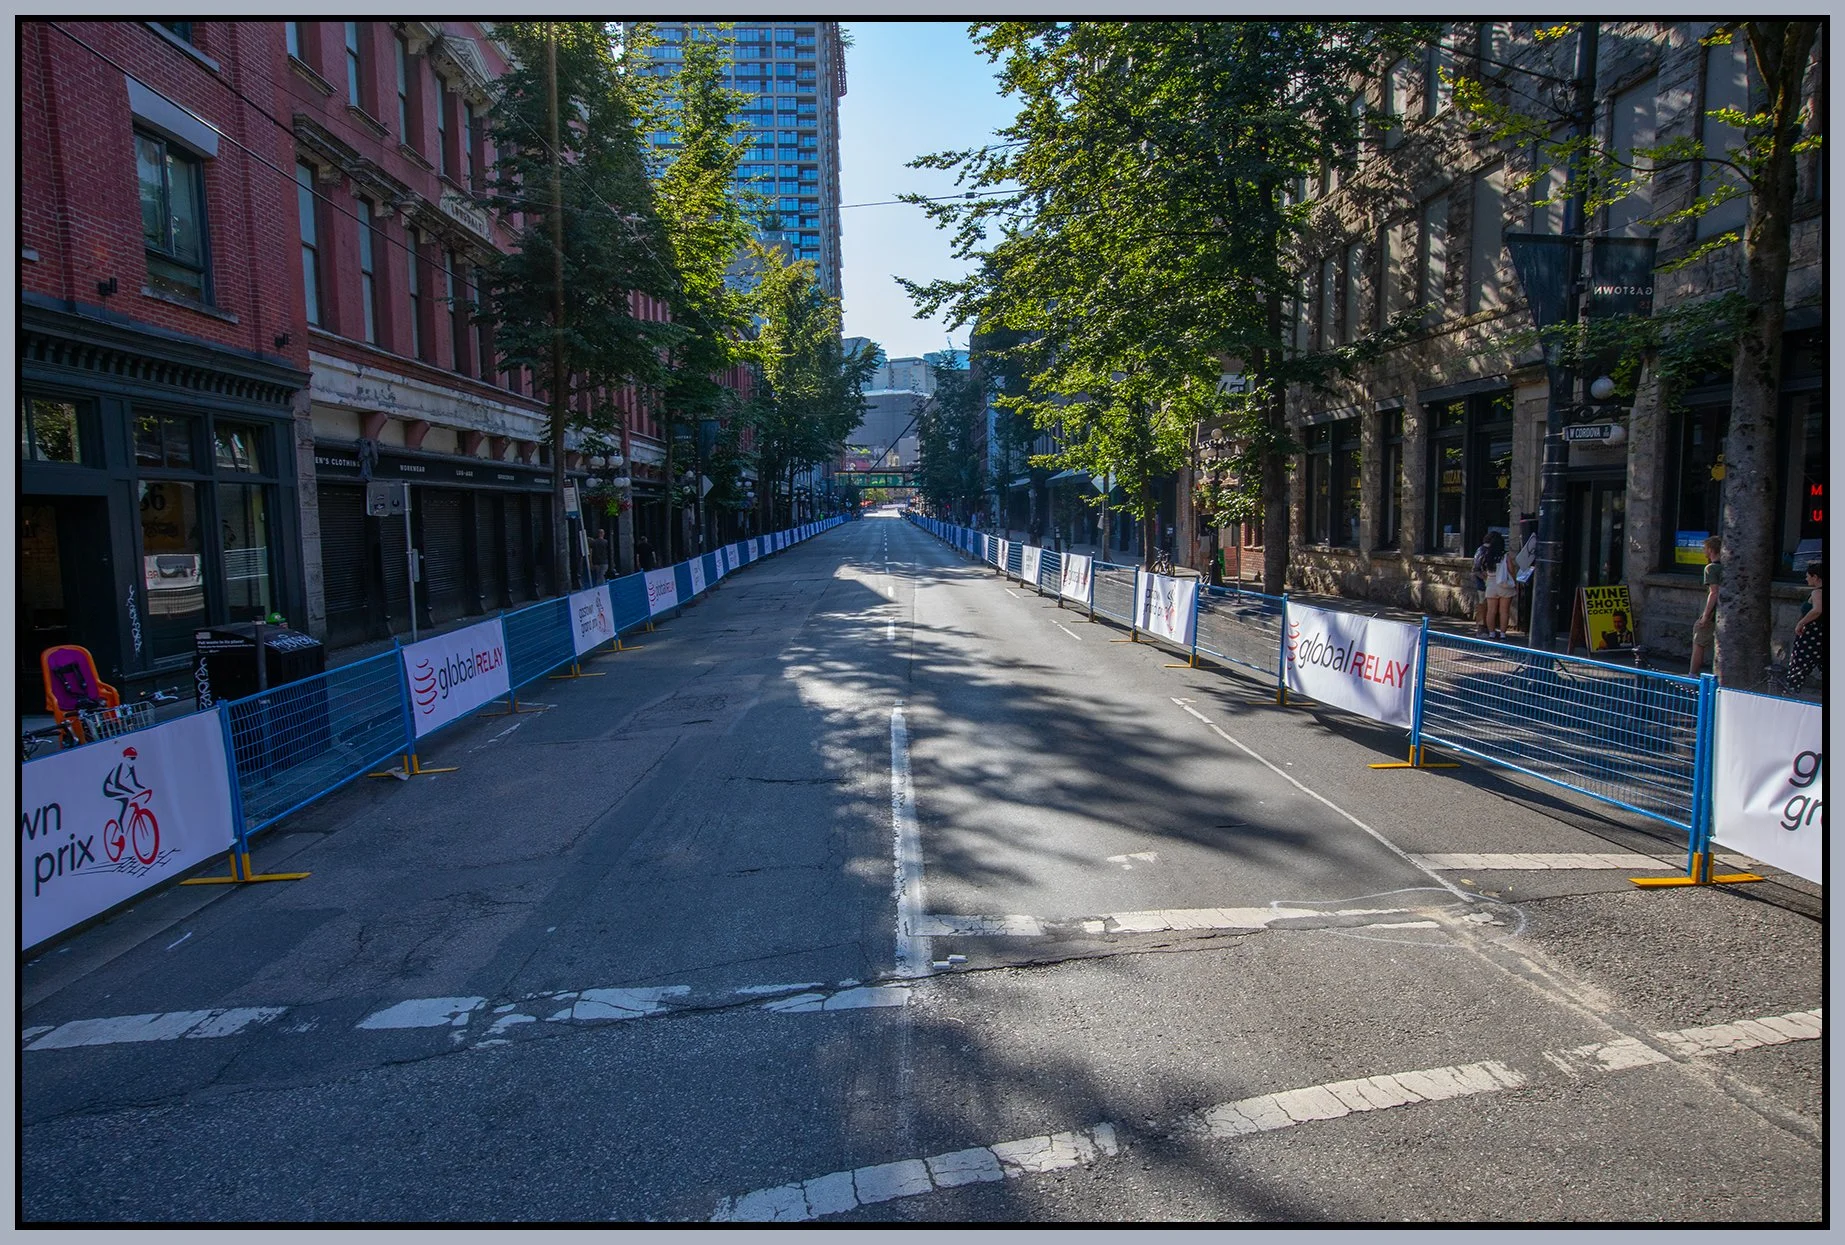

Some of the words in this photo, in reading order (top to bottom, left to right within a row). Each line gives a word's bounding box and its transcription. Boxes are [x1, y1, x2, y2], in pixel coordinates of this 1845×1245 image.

[1569, 428, 1575, 438] W
[1575, 426, 1601, 438] CORDOVA
[315, 456, 329, 465] EN'S
[400, 464, 426, 473] WORKWEAR
[1585, 588, 1627, 599] WINE
[1587, 599, 1629, 609] SHOTS
[35, 833, 95, 897] prix
